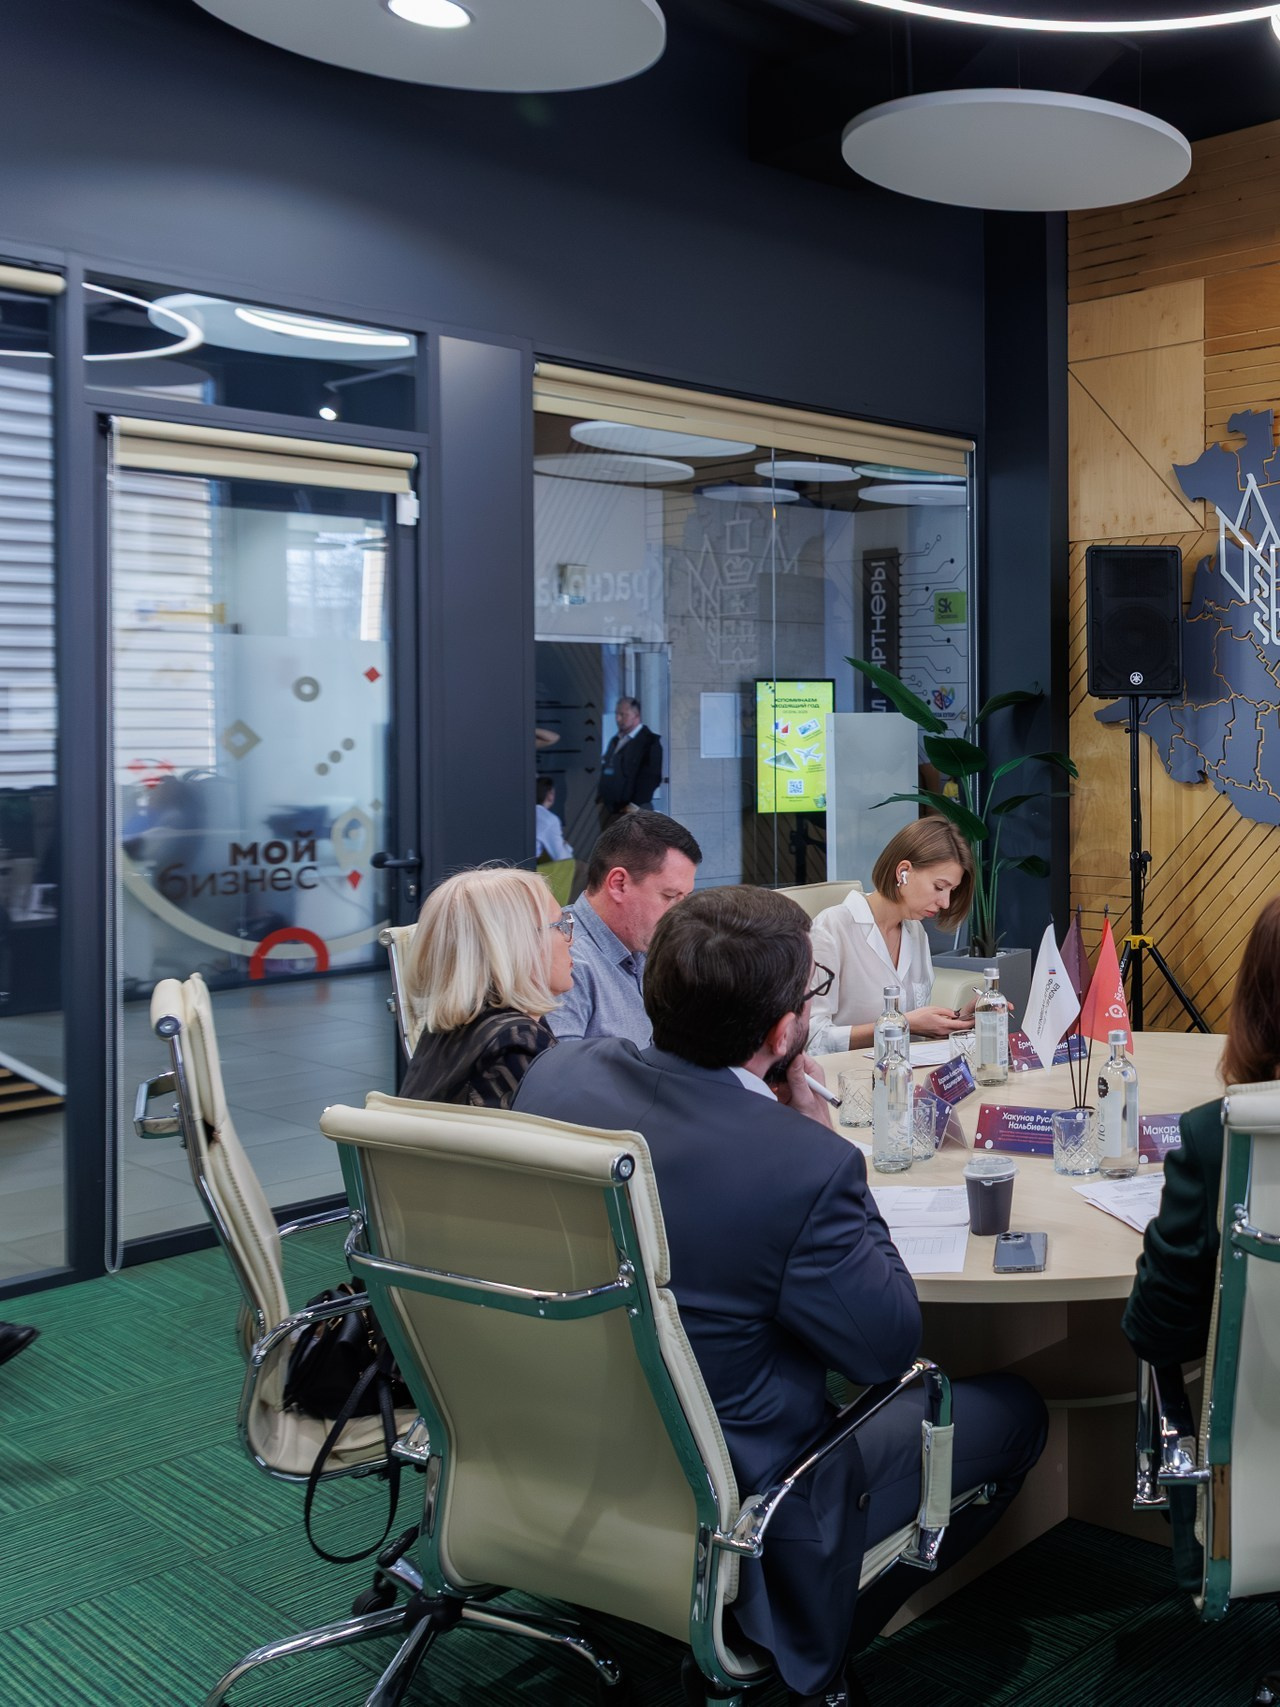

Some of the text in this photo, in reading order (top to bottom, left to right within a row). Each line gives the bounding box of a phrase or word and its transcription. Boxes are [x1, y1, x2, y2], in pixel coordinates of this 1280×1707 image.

[229, 830, 318, 867] мой
[157, 863, 320, 901] бизнес
[1002, 1112, 1036, 1124] Хакунов
[1161, 1133, 1182, 1144] Ива
